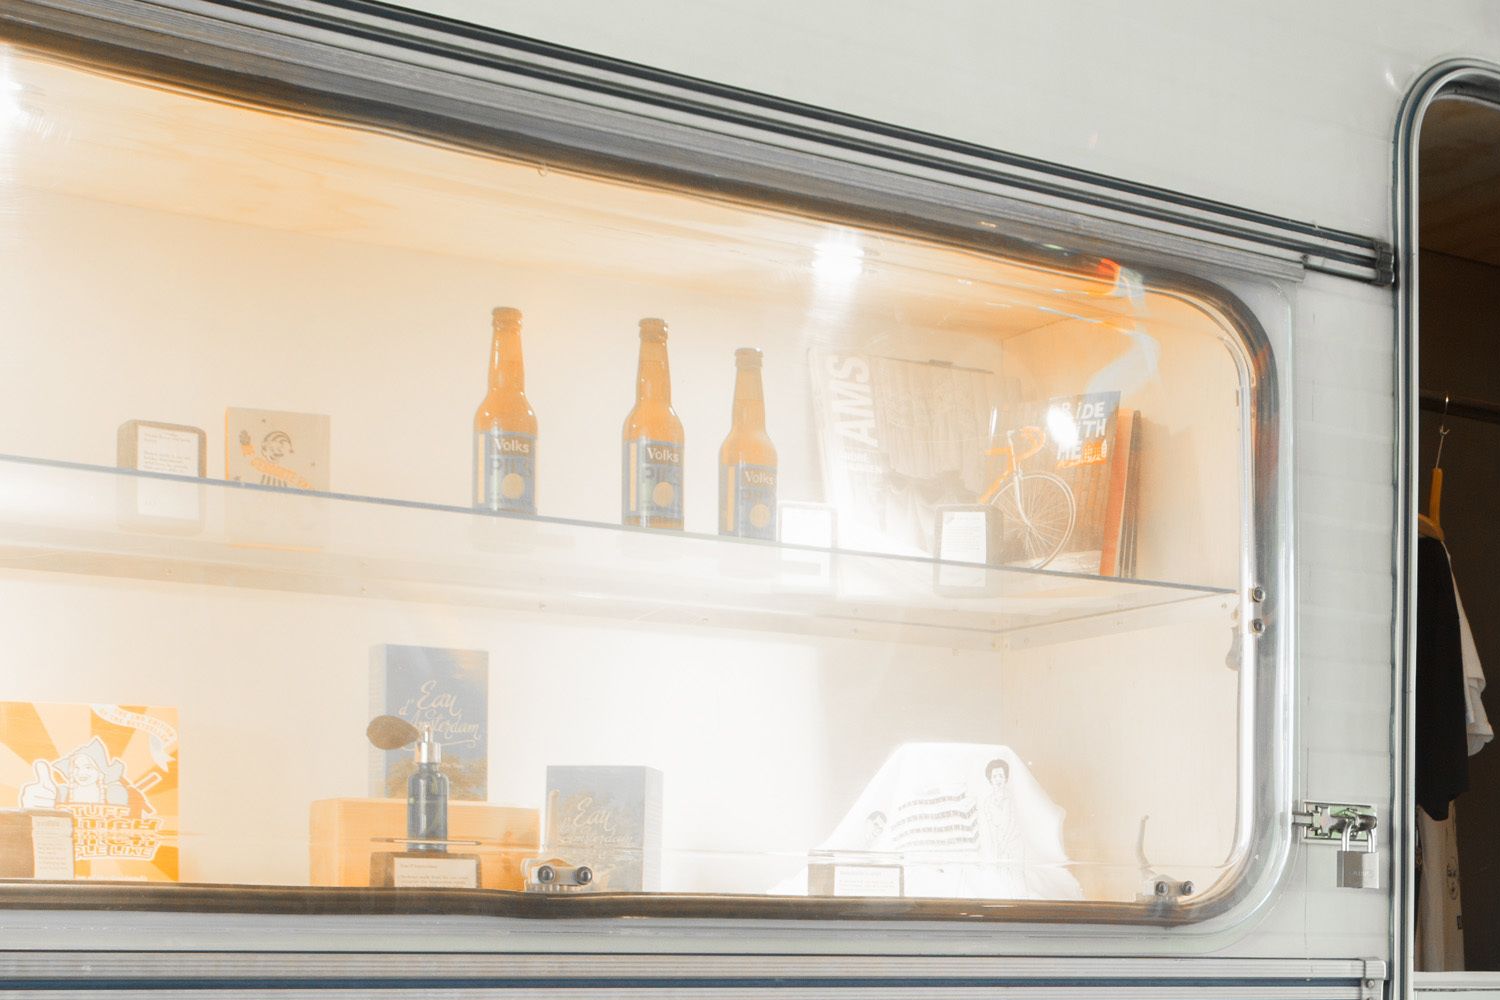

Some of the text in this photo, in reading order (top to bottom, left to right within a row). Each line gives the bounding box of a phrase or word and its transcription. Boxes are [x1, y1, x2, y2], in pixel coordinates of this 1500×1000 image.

[494, 438, 530, 454] Volks
[646, 447, 680, 463] Volks
[417, 679, 460, 716] Eau
[68, 804, 130, 818] TUFF
[573, 796, 616, 831] Eau
